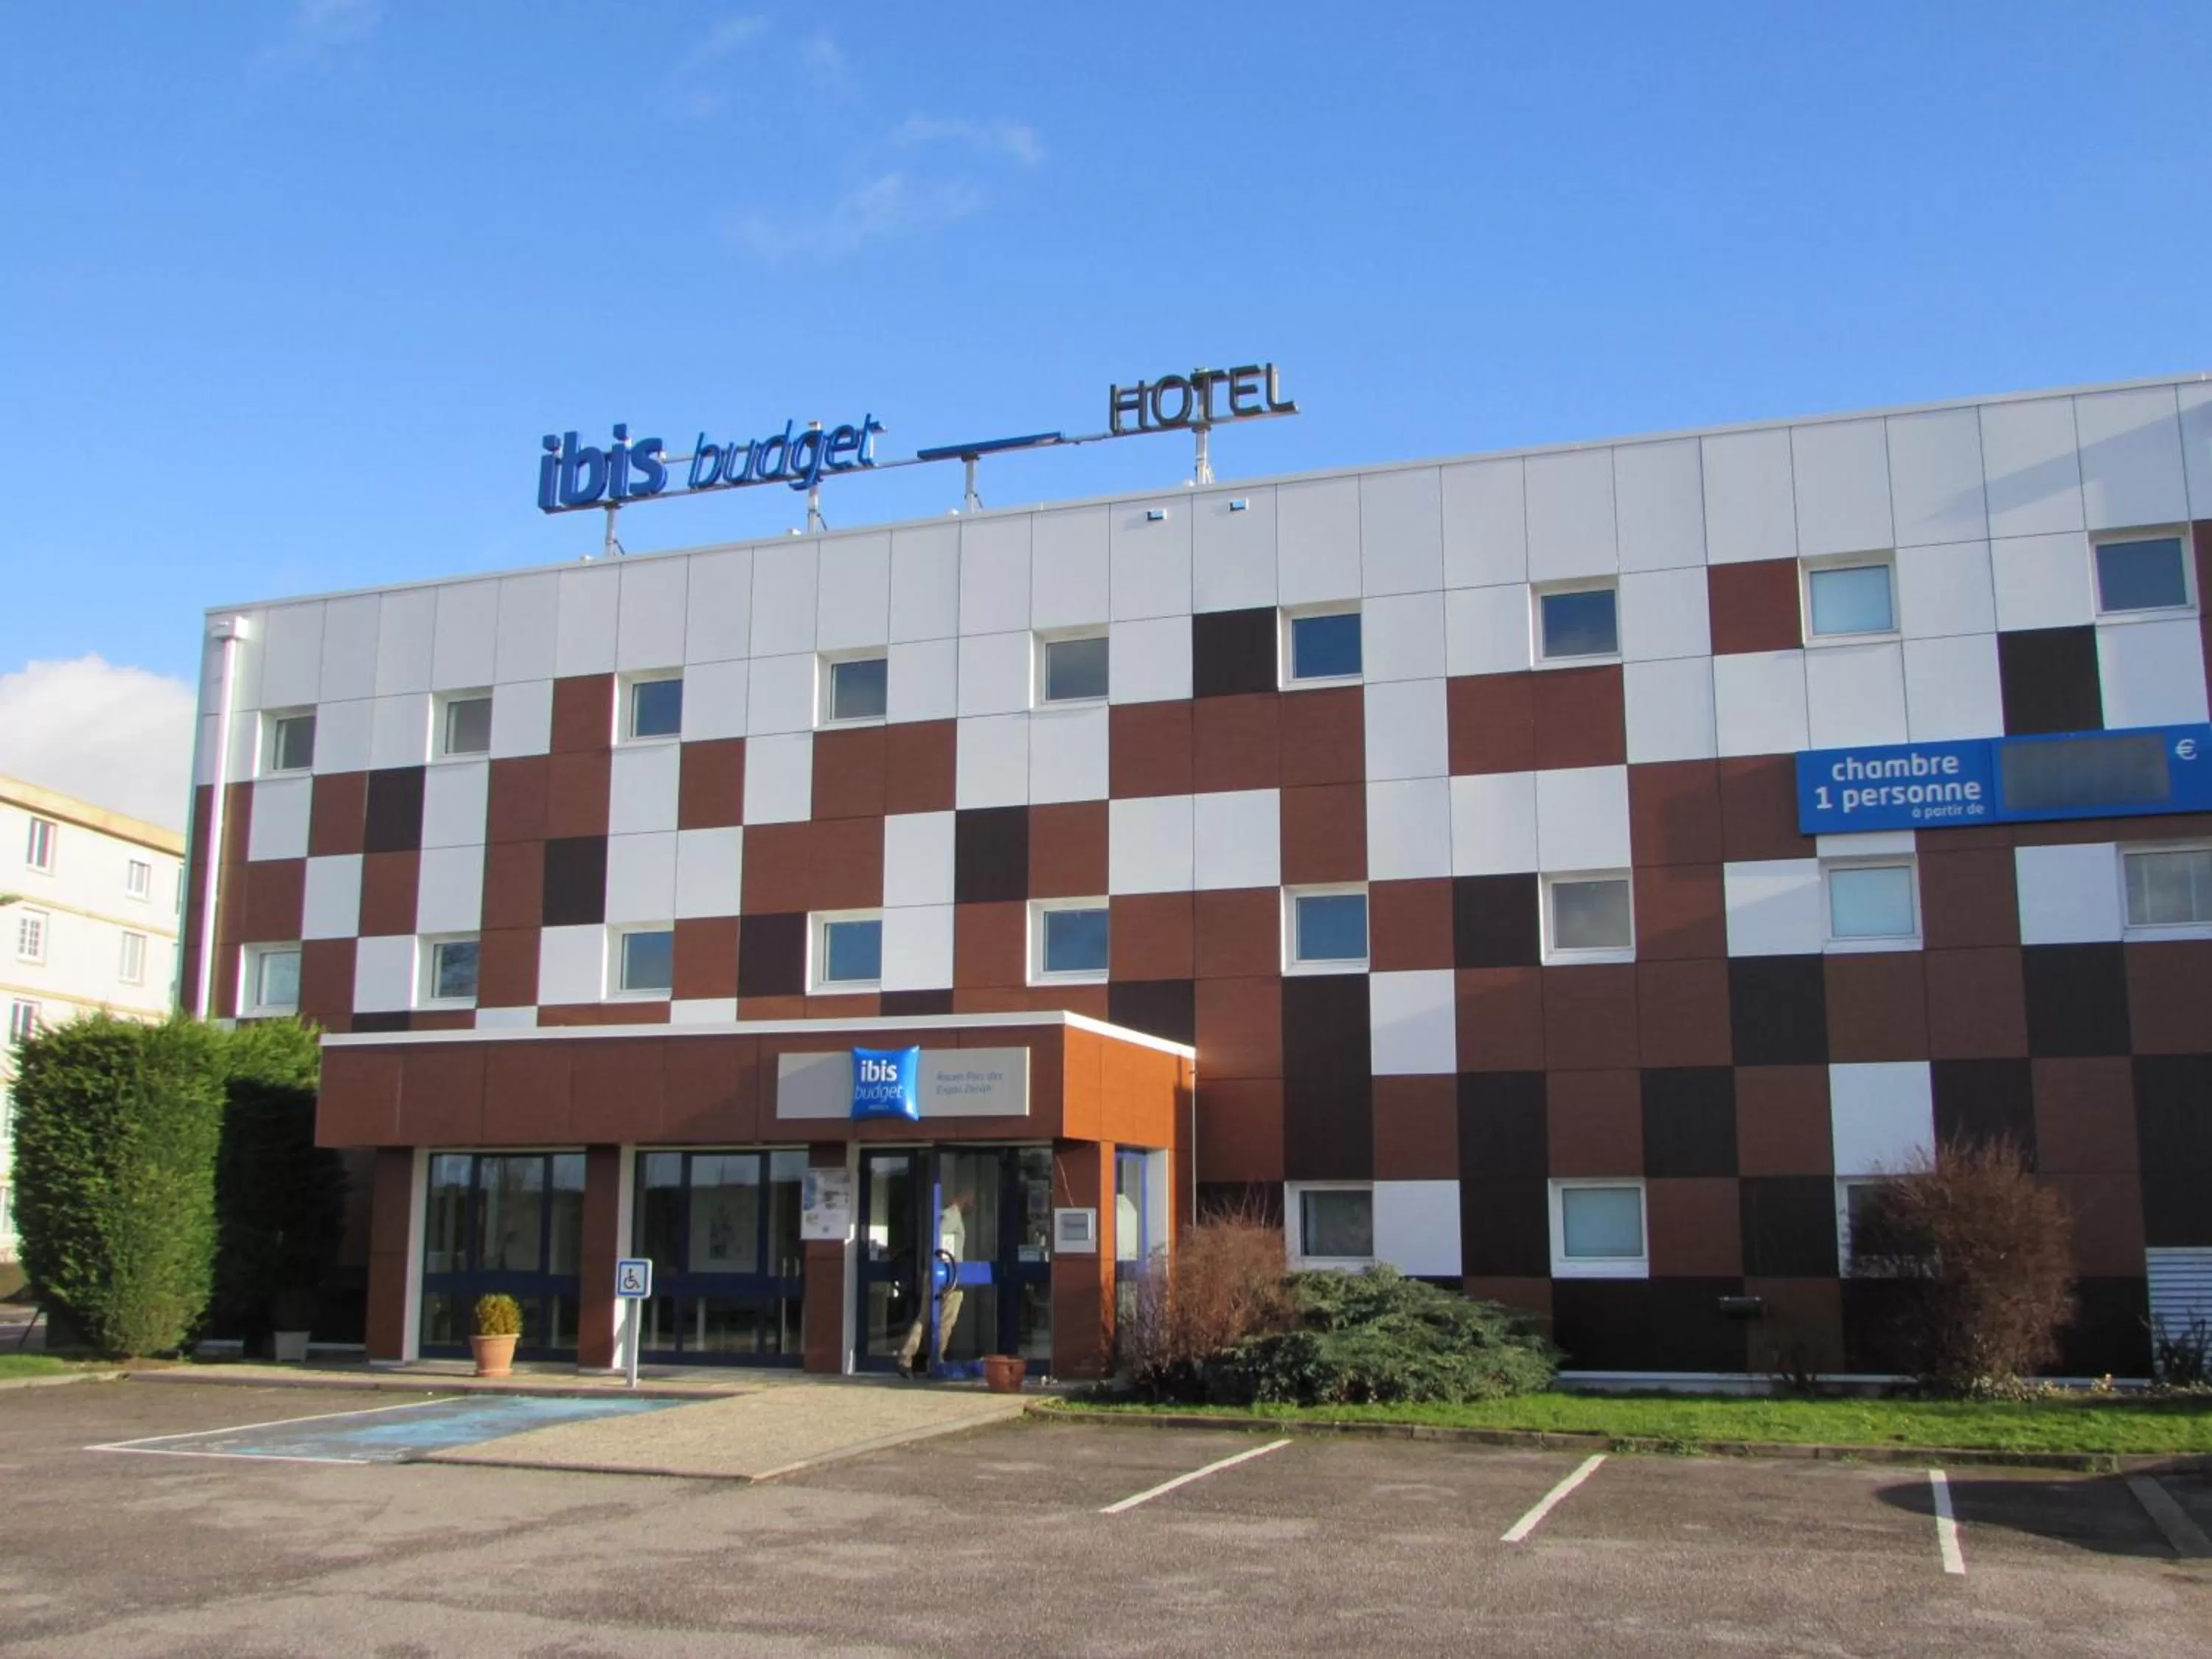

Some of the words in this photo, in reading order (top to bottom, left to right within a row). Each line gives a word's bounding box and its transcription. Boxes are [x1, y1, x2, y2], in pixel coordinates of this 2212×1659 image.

[1110, 363, 1298, 436] HOTEL
[538, 423, 667, 513] ibis
[688, 413, 887, 491] budget
[2176, 739, 2197, 760] €
[1832, 753, 1959, 781] chambre
[1815, 787, 1832, 809] 1
[1843, 782, 1982, 813] personne
[1924, 804, 1963, 819] partir
[1966, 803, 1985, 815] de
[860, 1060, 897, 1082] ibis
[855, 1084, 903, 1103] budget
